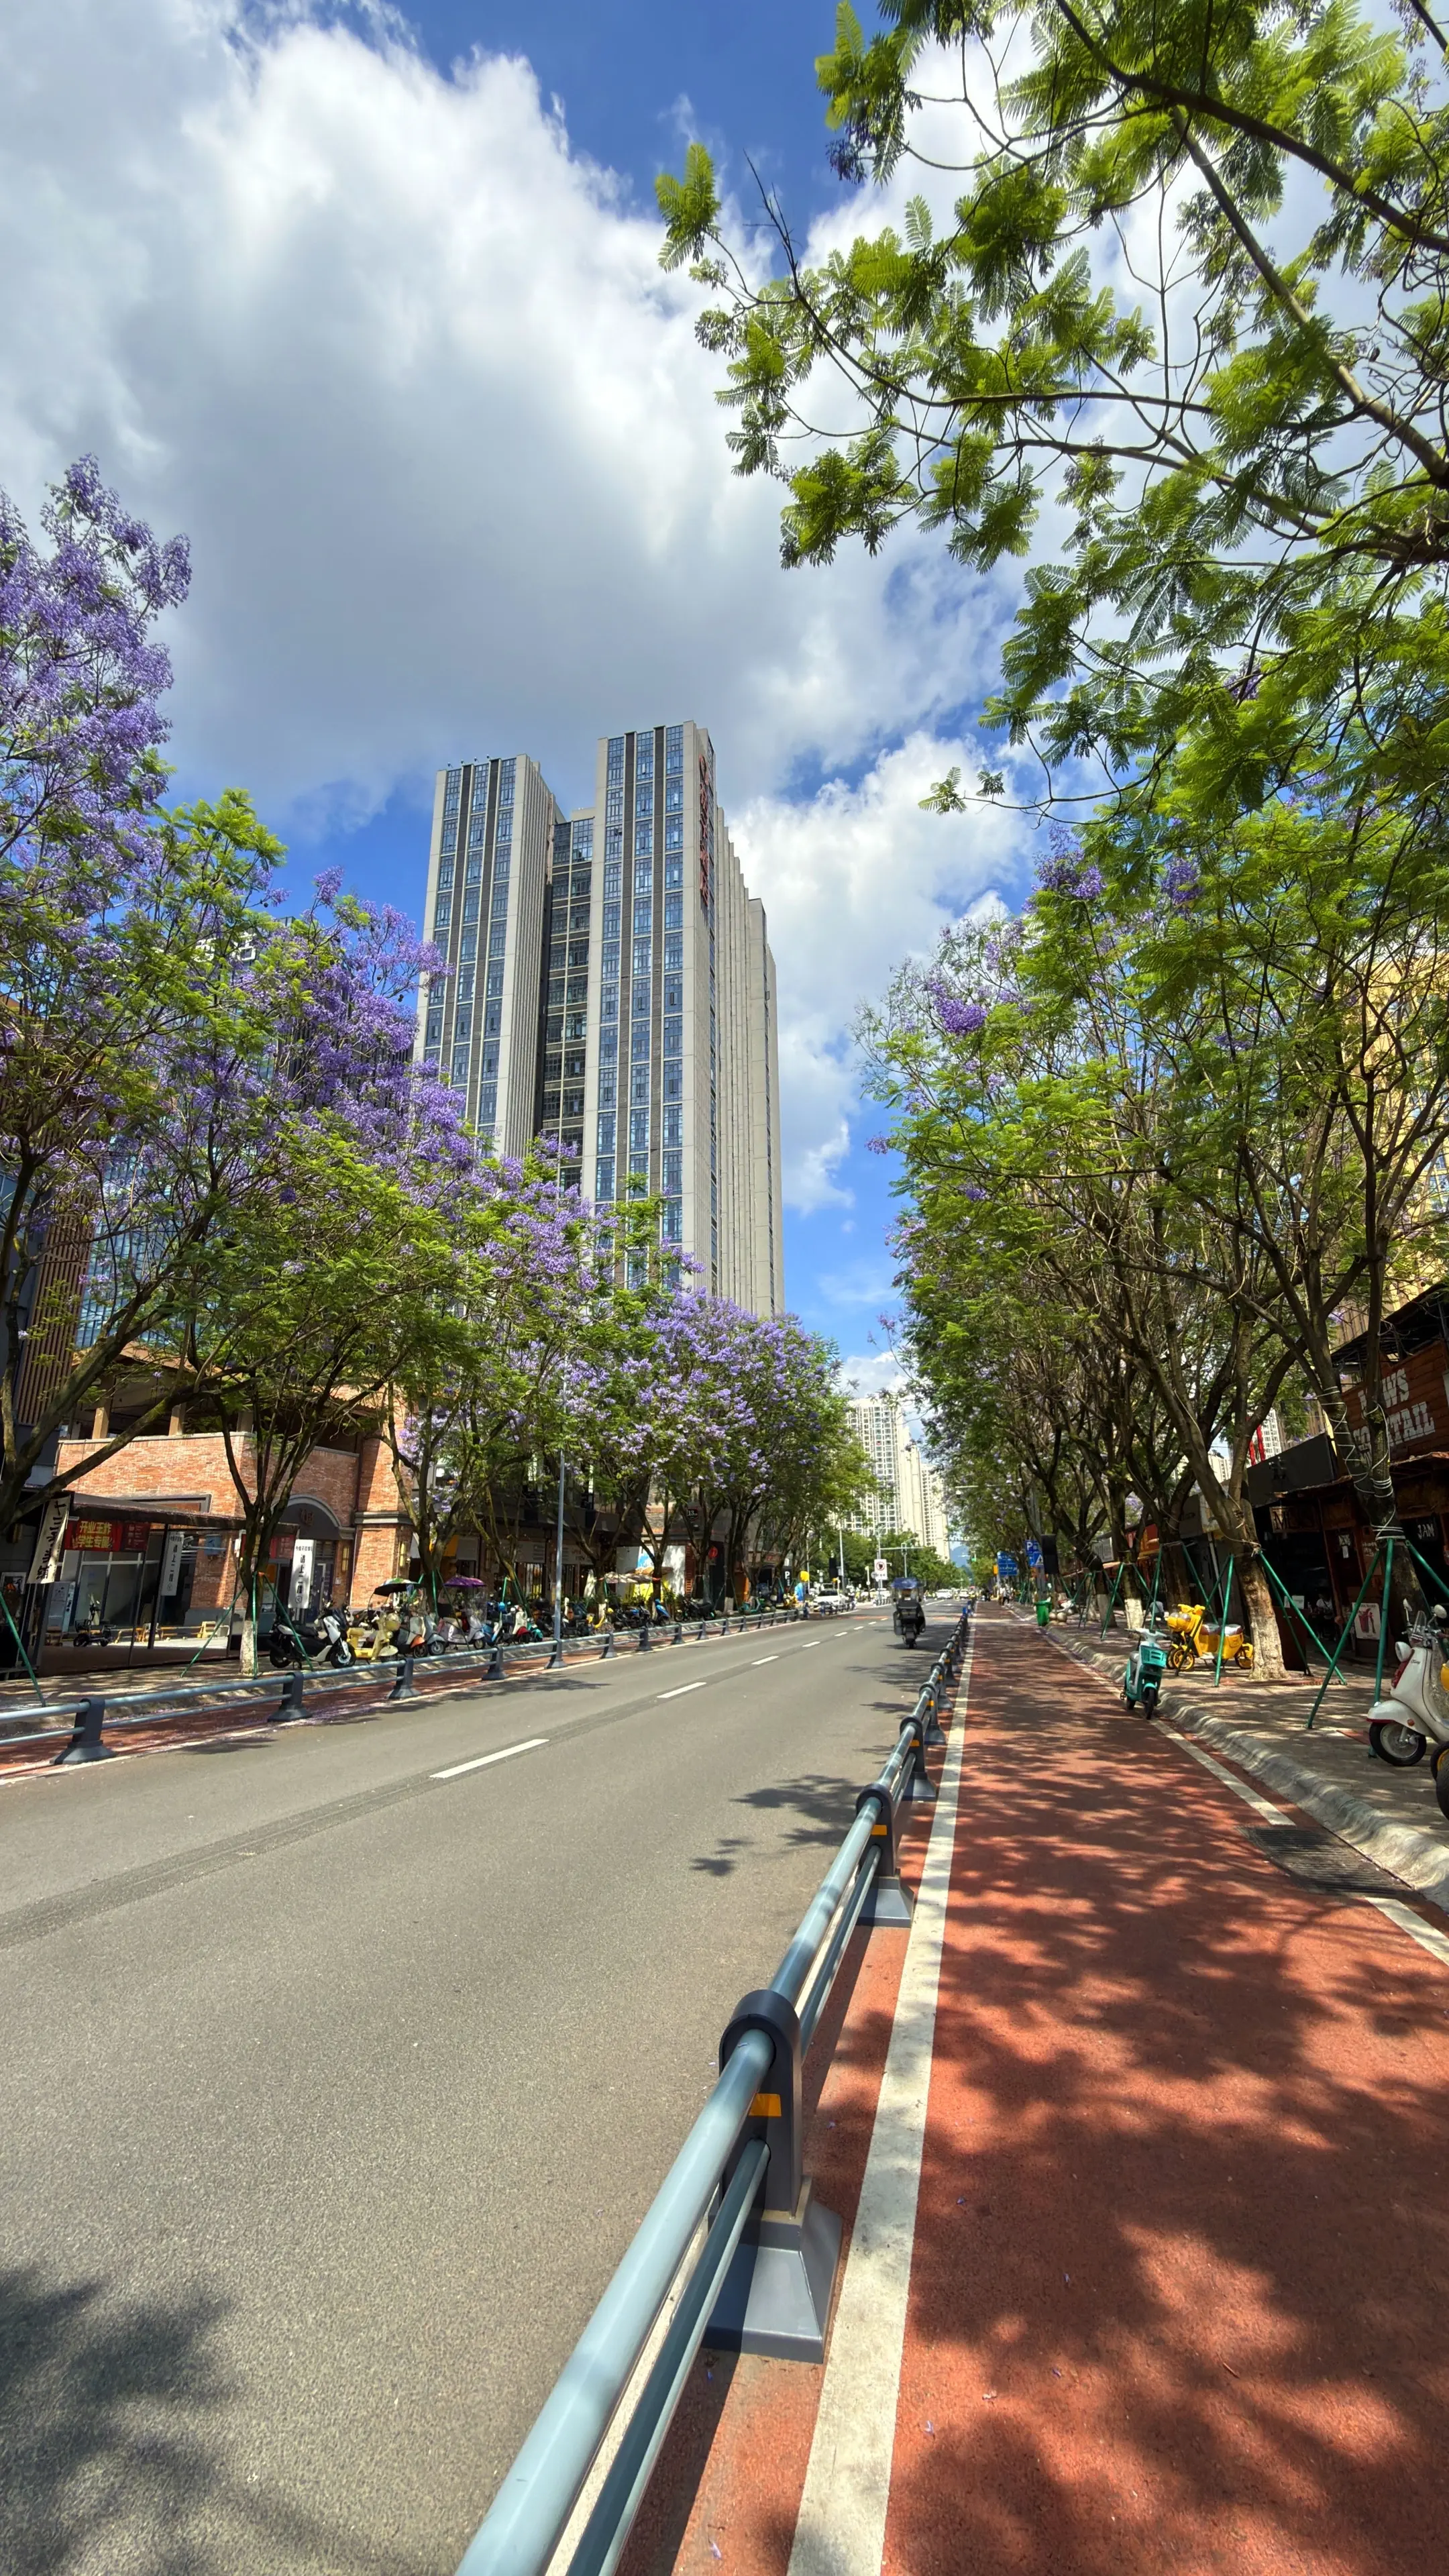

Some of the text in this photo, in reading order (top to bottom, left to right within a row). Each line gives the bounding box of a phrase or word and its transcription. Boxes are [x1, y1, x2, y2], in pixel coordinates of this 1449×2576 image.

[1417, 1523, 1435, 1540] JAM
[1026, 1542, 1033, 1551] P
[784, 1571, 790, 1580] P
